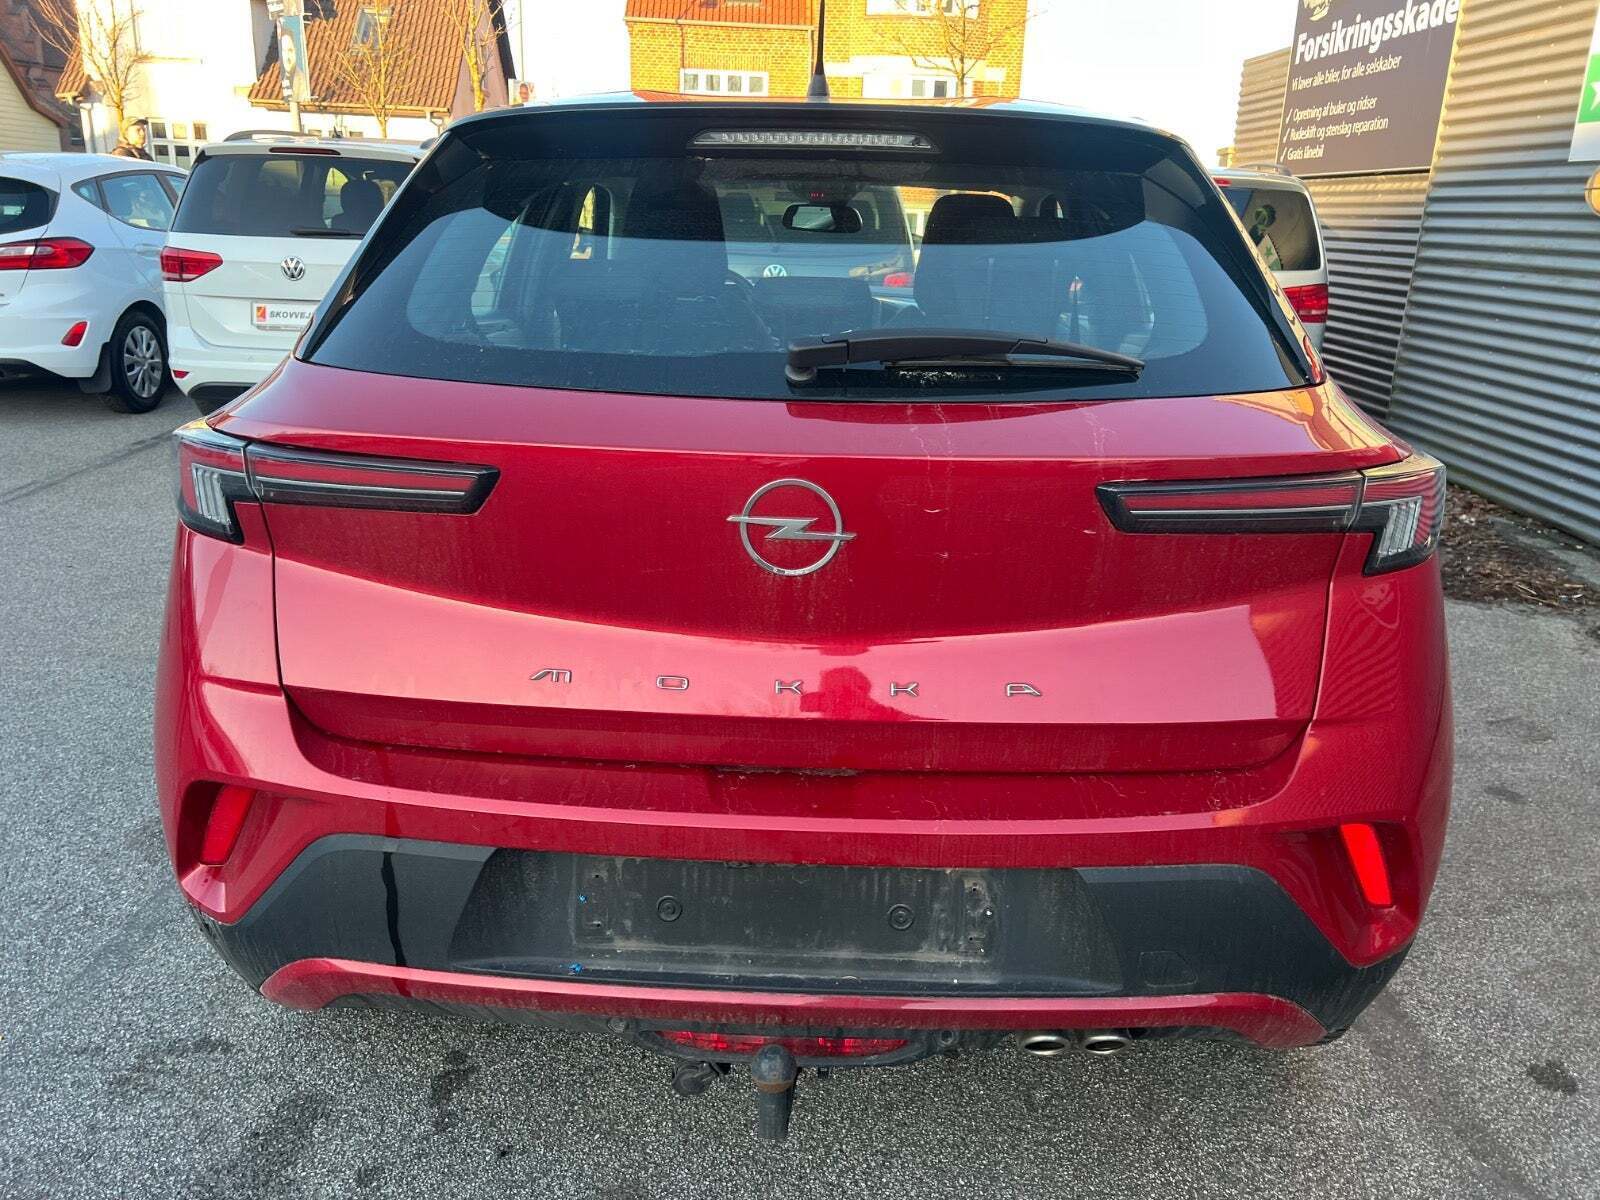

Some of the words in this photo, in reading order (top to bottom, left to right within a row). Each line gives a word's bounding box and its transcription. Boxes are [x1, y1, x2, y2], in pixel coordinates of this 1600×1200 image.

[1295, 0, 1459, 64] Forsikringsskade
[1313, 71, 1325, 86] alle
[1341, 65, 1352, 80] for
[1352, 62, 1365, 78] alle
[1365, 54, 1402, 75] selskaber
[1293, 106, 1322, 122] Opretning
[1322, 102, 1330, 117] af
[1330, 100, 1347, 115] buler
[1347, 101, 1356, 116] og
[1357, 95, 1378, 111] ridser
[1316, 126, 1325, 141] og
[1325, 121, 1352, 137] stenslag
[1352, 116, 1389, 136] reparation
